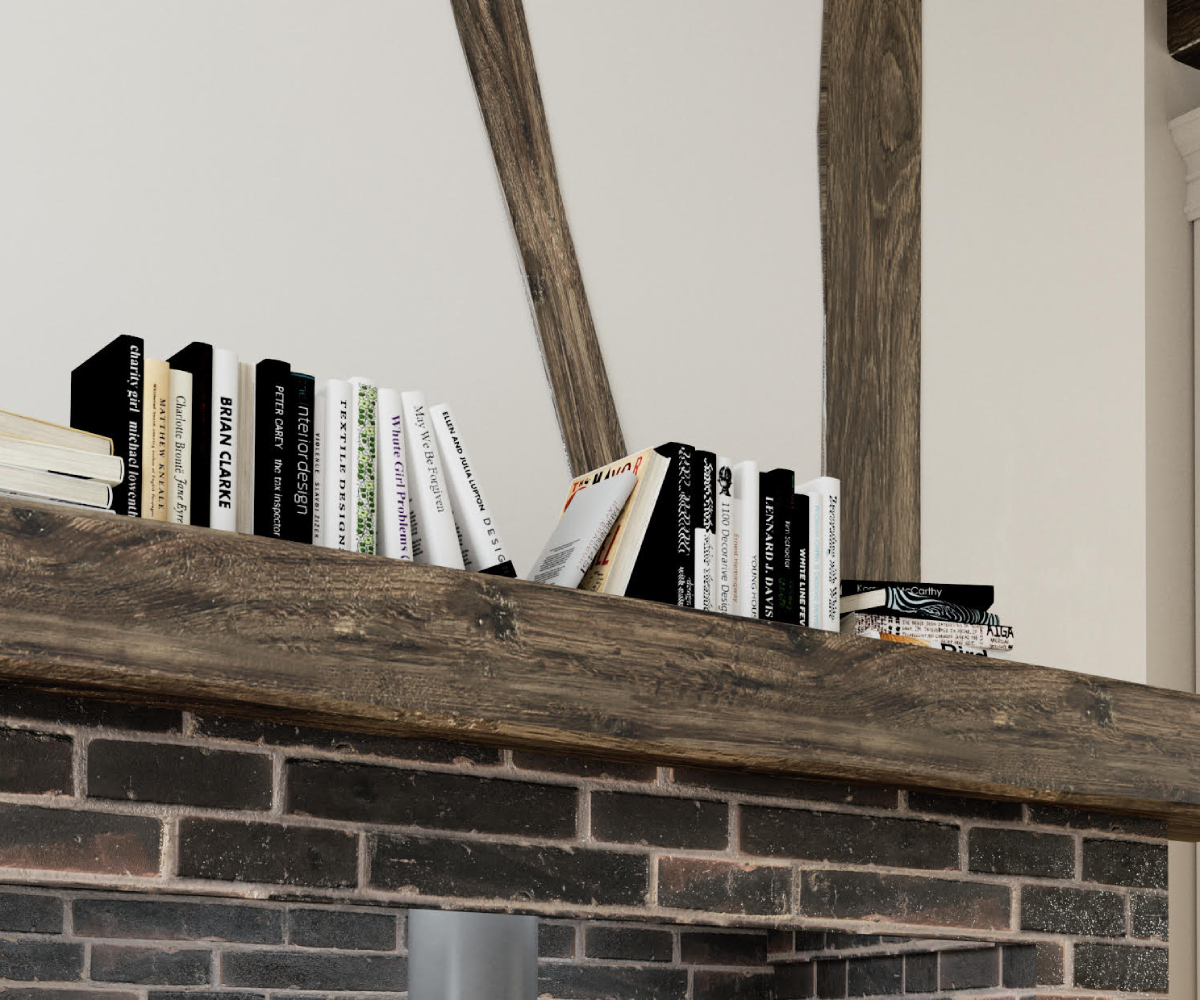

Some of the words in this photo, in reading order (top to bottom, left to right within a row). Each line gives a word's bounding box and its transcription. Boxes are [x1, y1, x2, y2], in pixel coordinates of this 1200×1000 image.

[127, 344, 141, 387] charity
[127, 390, 141, 412] girl
[274, 385, 284, 415] PETER
[158, 398, 166, 458] MATTHEW
[175, 395, 185, 439] Charlotte
[219, 397, 233, 446] BRIAN
[413, 404, 425, 431] May
[128, 421, 140, 468] michael
[274, 418, 284, 450] CAREY
[340, 400, 348, 473] TEXTILE
[420, 430, 431, 448] We
[174, 442, 185, 474] Brontë
[274, 459, 282, 474] the
[394, 461, 405, 487] Girl
[424, 450, 435, 466] Be
[442, 411, 455, 434] ELLEN
[452, 436, 463, 455] AND
[459, 456, 472, 479] JULIA
[469, 479, 486, 511] LUPTON
[157, 463, 165, 510] KNEALE
[173, 476, 187, 500] Jane
[219, 451, 232, 509] CLARKE
[274, 477, 282, 491] tax
[427, 466, 445, 513] Forgiven
[173, 503, 187, 524] Eyre
[272, 494, 282, 537] inspector
[396, 490, 409, 551] Problems
[721, 503, 730, 526] 1100
[765, 496, 774, 561] LENNARD
[765, 563, 774, 574] J.
[799, 548, 807, 580] WHITE
[718, 584, 729, 614] Desig
[765, 577, 774, 618] DAVIS
